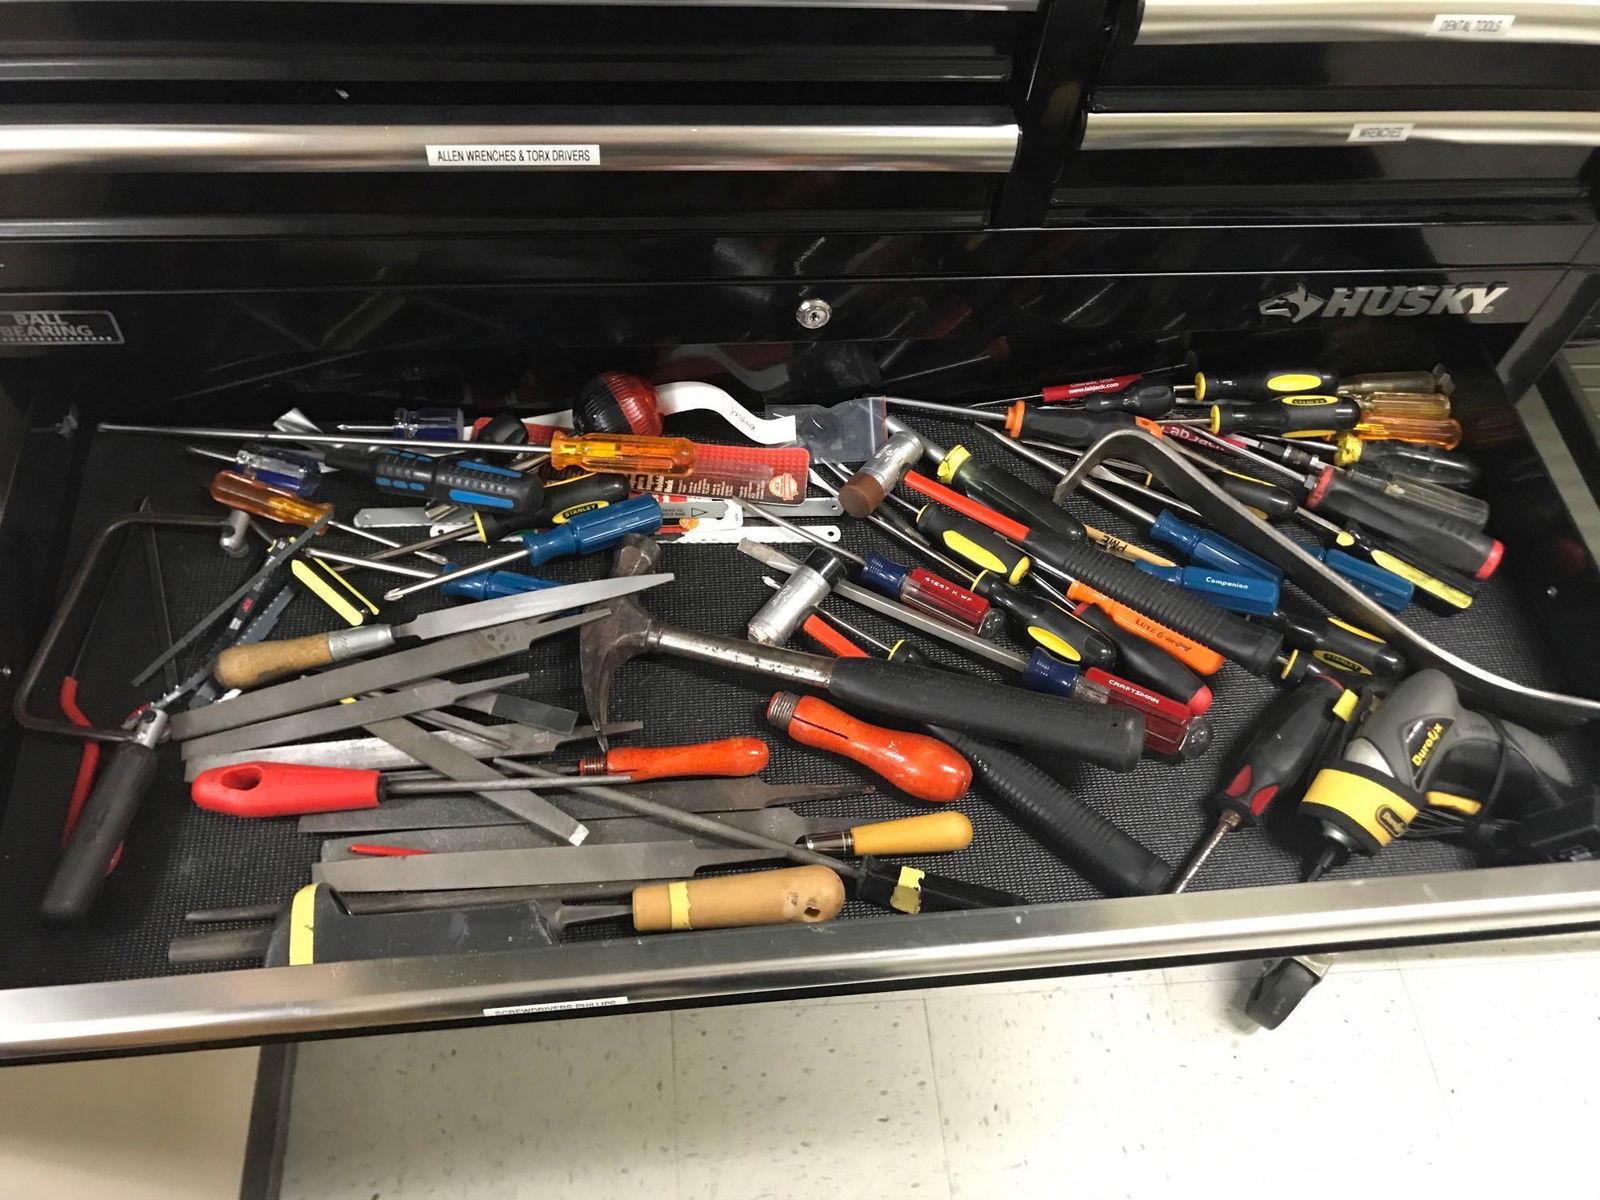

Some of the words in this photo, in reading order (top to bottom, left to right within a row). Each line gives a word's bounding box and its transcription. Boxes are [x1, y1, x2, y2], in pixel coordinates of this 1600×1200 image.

[1439, 20, 1471, 32] DENTAL
[1475, 20, 1503, 32] TOOLS
[1358, 127, 1404, 138] WRENCHES
[437, 150, 465, 162] ALLEN
[467, 150, 516, 162] WRENCHES
[518, 150, 525, 161] &
[527, 150, 551, 162] TORX
[552, 150, 591, 162] DRIVERS
[1320, 285, 1509, 318] HUSKY
[12, 313, 69, 325] BALL
[1068, 382, 1120, 394] www.labjack.com
[563, 504, 597, 519] STANLEY
[1205, 576, 1249, 590] Companion
[1108, 679, 1160, 704] CRAFTSMAN
